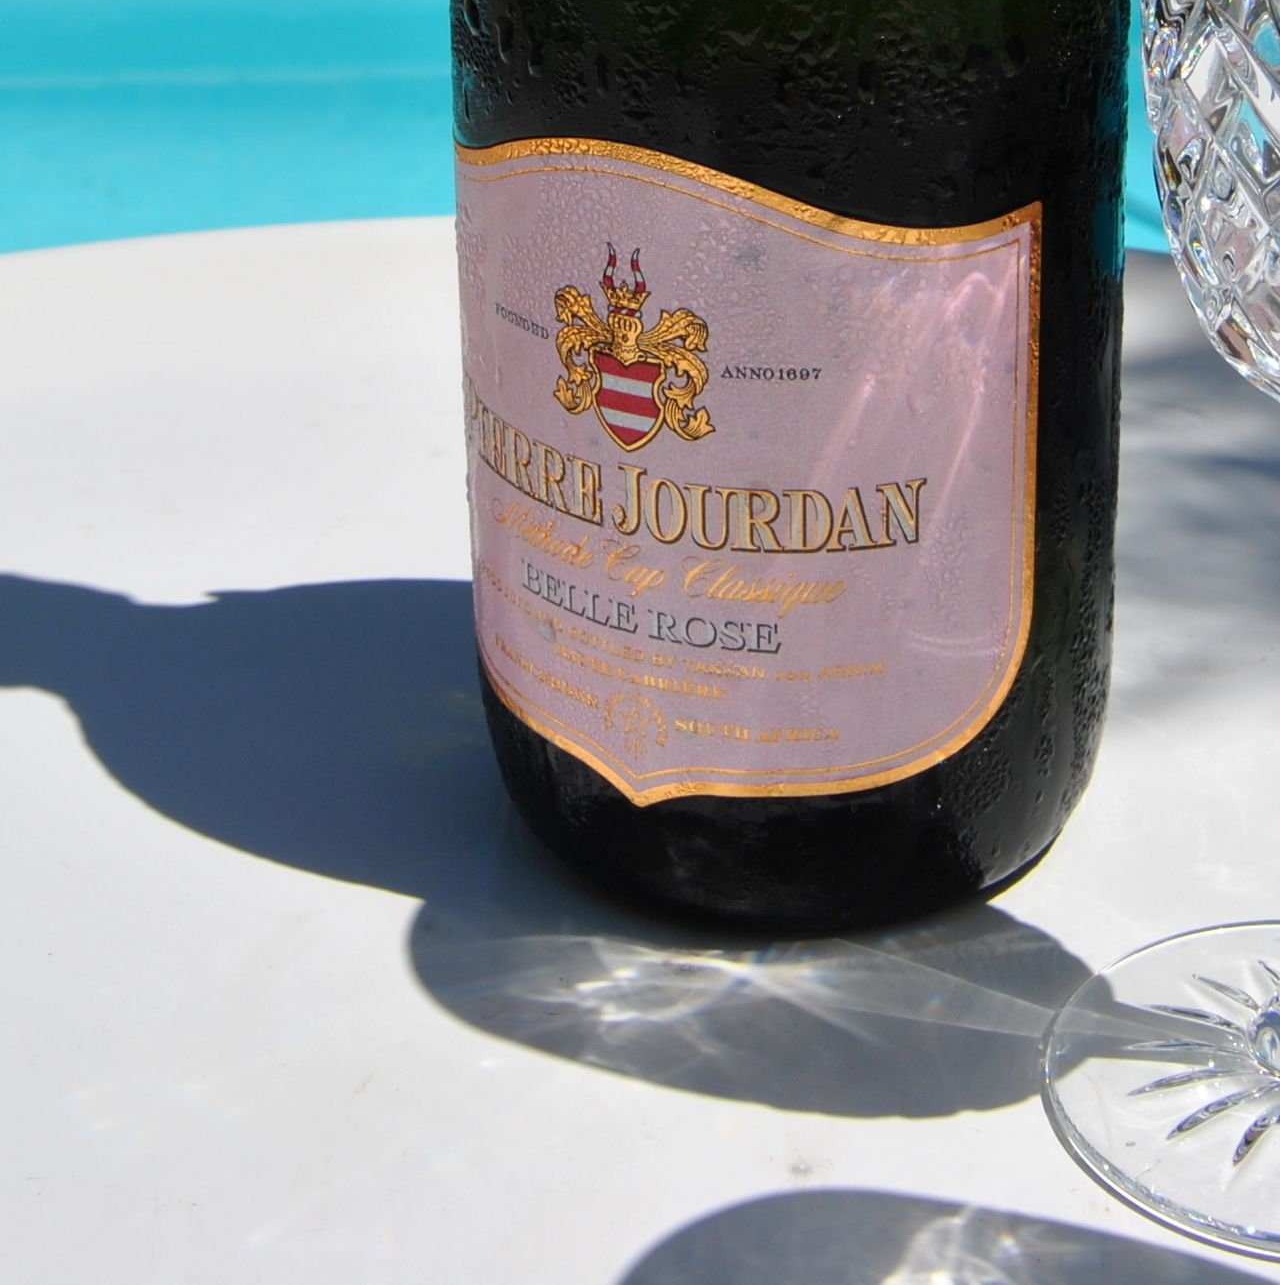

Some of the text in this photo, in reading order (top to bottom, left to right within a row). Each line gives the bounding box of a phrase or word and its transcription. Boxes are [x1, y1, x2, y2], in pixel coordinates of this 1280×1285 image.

[720, 365, 775, 380] ANNO
[612, 463, 927, 553] JOURDAN
[521, 559, 638, 634] BELLE
[648, 608, 782, 654] ROSE
[602, 538, 666, 598] Cap
[681, 555, 847, 618] Classique
[570, 626, 645, 662] BOTTLED
[653, 652, 676, 669] BY
[674, 718, 839, 743] SOUTH AFRICA
